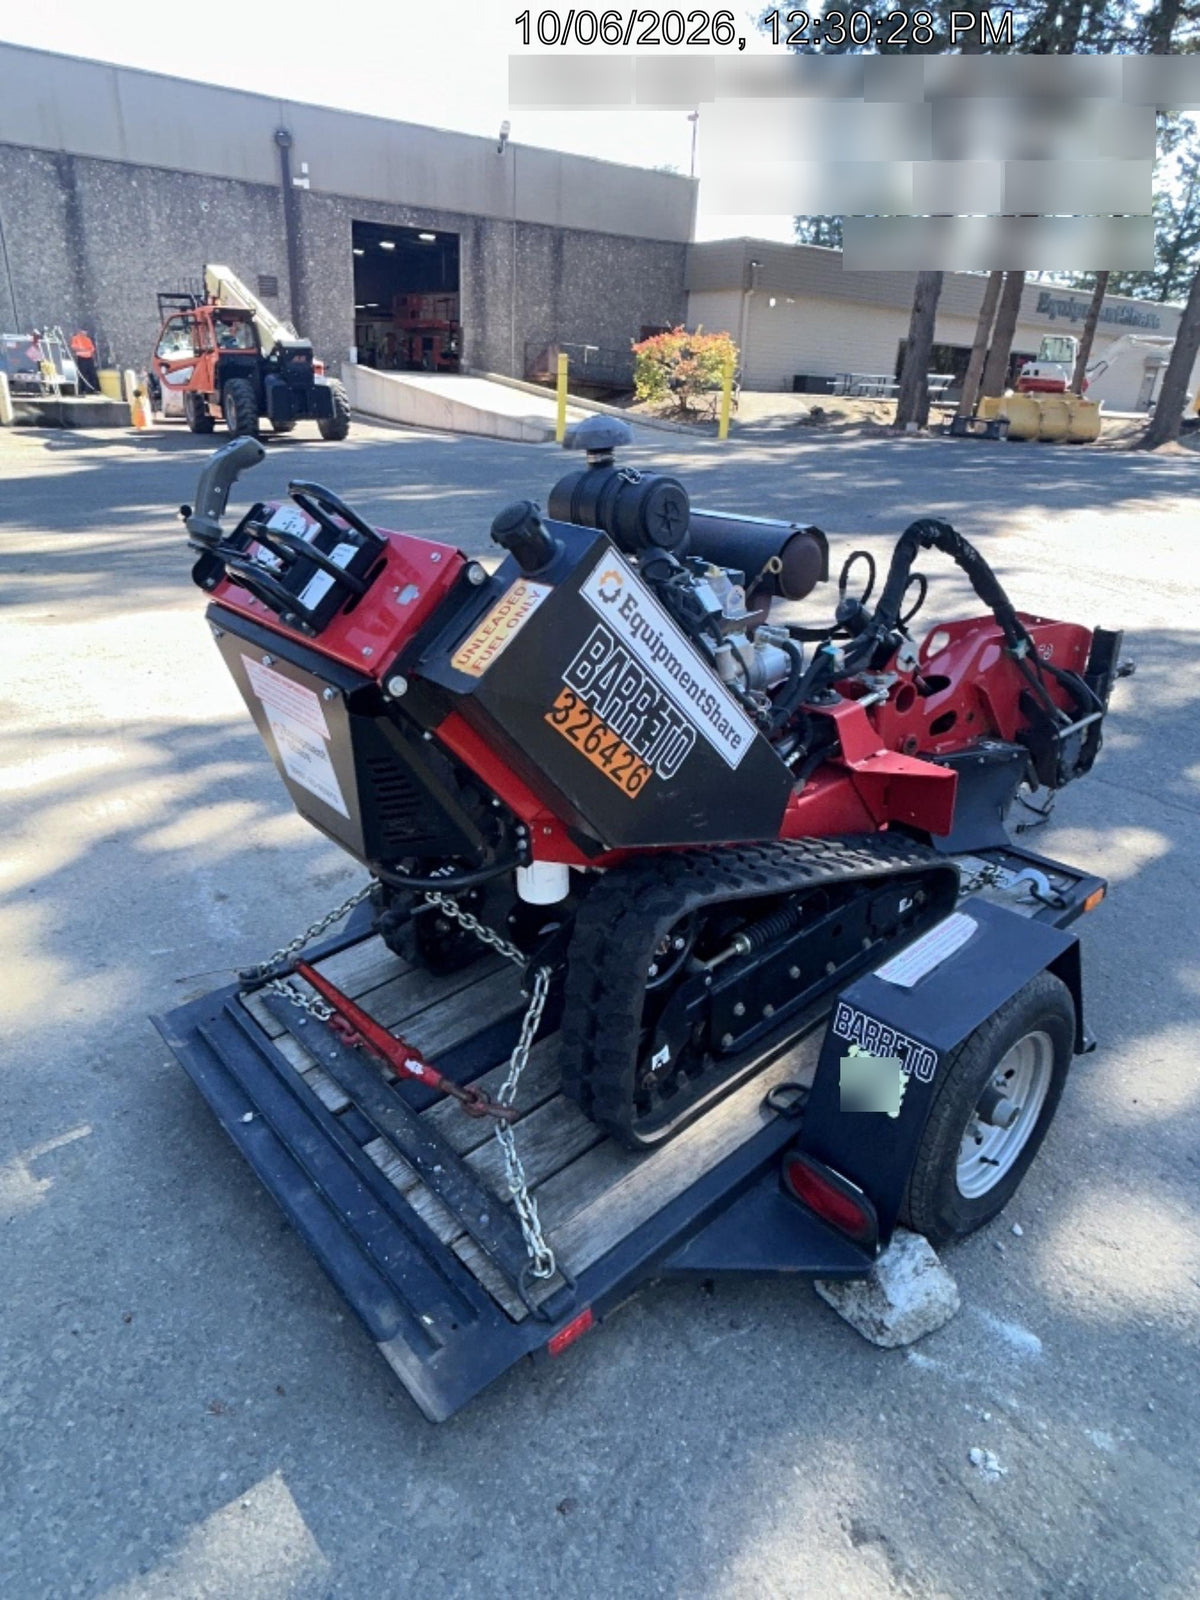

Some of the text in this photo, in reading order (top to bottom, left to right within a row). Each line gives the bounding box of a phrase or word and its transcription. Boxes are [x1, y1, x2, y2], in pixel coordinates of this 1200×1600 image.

[456, 585, 527, 666] UNLEADED
[471, 589, 541, 671] FUEL ONLY
[617, 592, 744, 750] EquipmentShare
[550, 691, 649, 793] 326426
[561, 622, 698, 780] BARRETO
